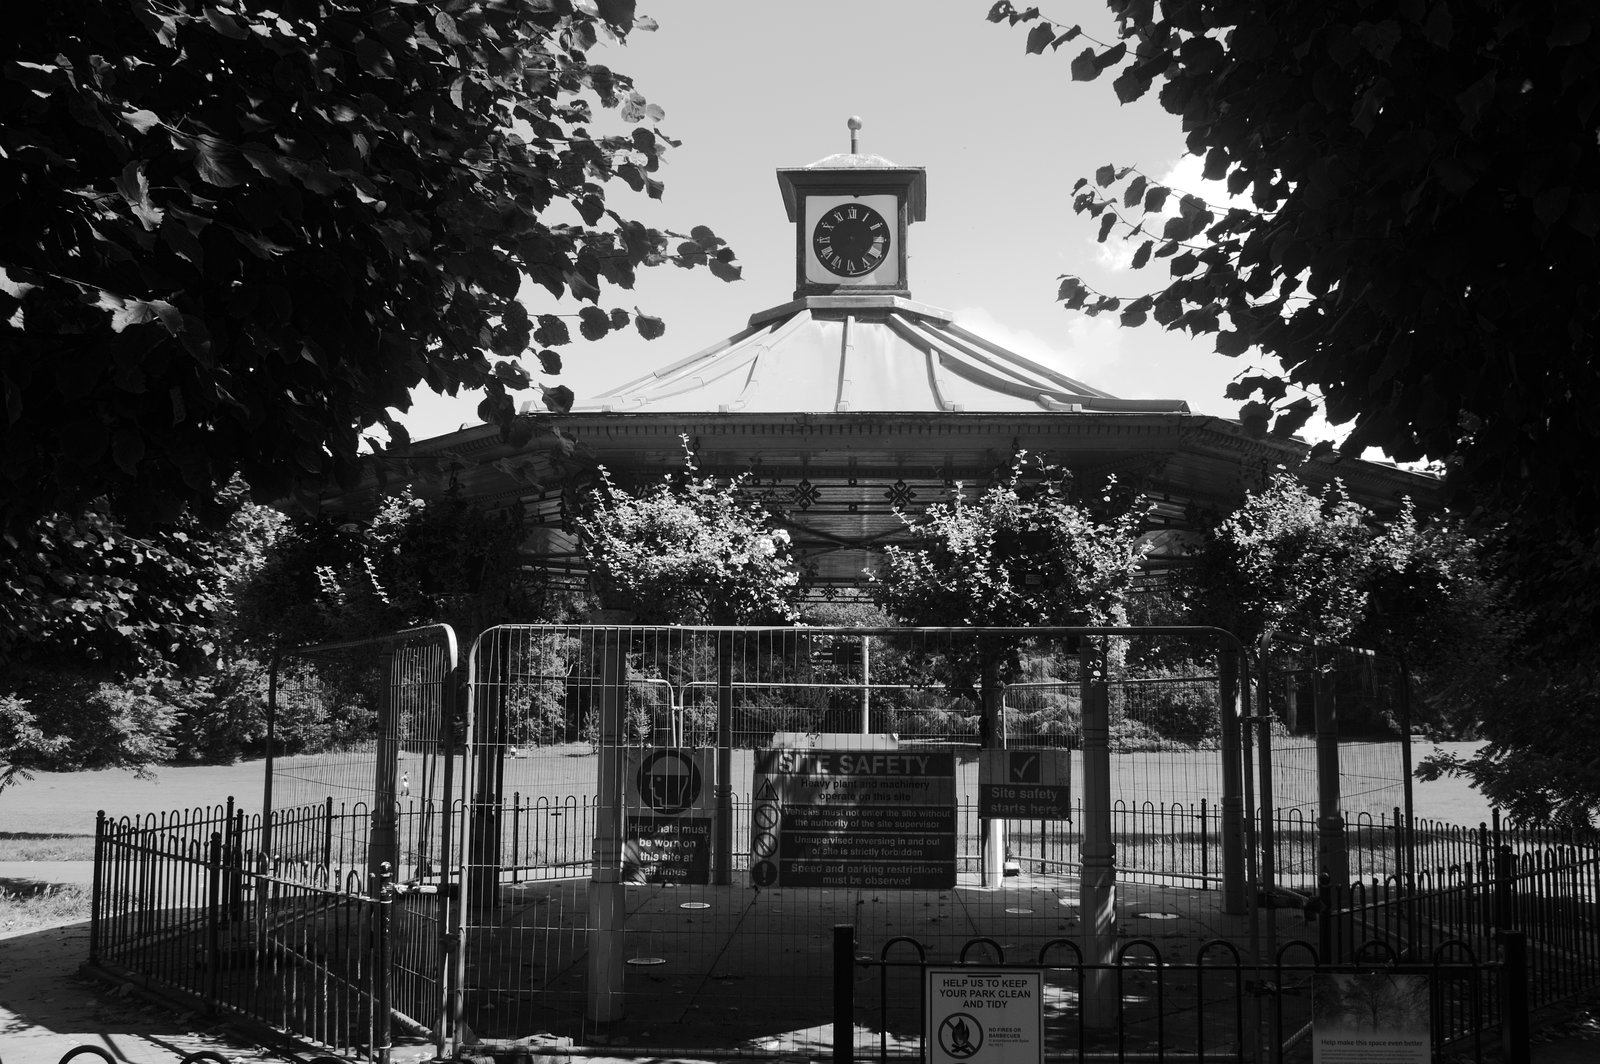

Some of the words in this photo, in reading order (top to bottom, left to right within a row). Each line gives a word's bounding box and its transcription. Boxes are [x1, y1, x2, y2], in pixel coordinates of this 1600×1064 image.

[834, 212, 844, 222] XI
[847, 209, 857, 219] XII
[862, 212, 869, 222] I
[779, 754, 831, 774] SITE
[839, 755, 930, 774] SAFETY
[801, 780, 829, 789] Heavy
[833, 780, 857, 790] plant
[860, 781, 877, 789] and
[881, 781, 929, 790] machinery
[819, 793, 855, 801] operate
[874, 793, 891, 801] this
[894, 793, 911, 801] site
[992, 787, 1015, 798] Site
[1019, 788, 1058, 801] safety
[785, 807, 819, 816] Vehicles
[822, 808, 843, 816] must
[886, 809, 898, 817] the
[920, 809, 950, 818] without
[991, 803, 1026, 813] starts
[1030, 803, 1058, 814] here
[630, 824, 654, 833] Hard
[658, 825, 678, 833] hats
[682, 825, 707, 834] must
[811, 819, 848, 828] authority
[852, 819, 860, 827] of
[862, 819, 874, 827] the
[895, 821, 939, 829] supervisor
[639, 838, 652, 847] be
[794, 836, 852, 846] Unsupervised
[856, 837, 895, 847] reversing
[898, 837, 905, 845] in
[908, 837, 924, 846] and
[927, 838, 940, 846] out
[640, 852, 658, 861] this
[662, 853, 680, 861] site
[683, 854, 693, 862] at
[841, 848, 848, 856] is
[850, 848, 879, 858] strictly
[881, 848, 923, 856] forbidden
[645, 867, 656, 876] all
[660, 867, 687, 876] times
[791, 864, 821, 874] Speed
[826, 864, 844, 873] and
[847, 865, 883, 876] parking
[887, 866, 943, 874] restrictions
[823, 876, 847, 884] must
[850, 876, 862, 885] be
[865, 876, 910, 885] observed
[943, 979, 968, 988] HELP
[971, 979, 983, 988] US
[985, 980, 999, 988] TO
[1002, 980, 1027, 988] KEEP
[940, 990, 967, 998] YOUR
[970, 990, 995, 998] PARK
[999, 990, 1030, 998] CLEAN
[963, 1000, 983, 1008] AND
[986, 1000, 1008, 1008] TIDY
